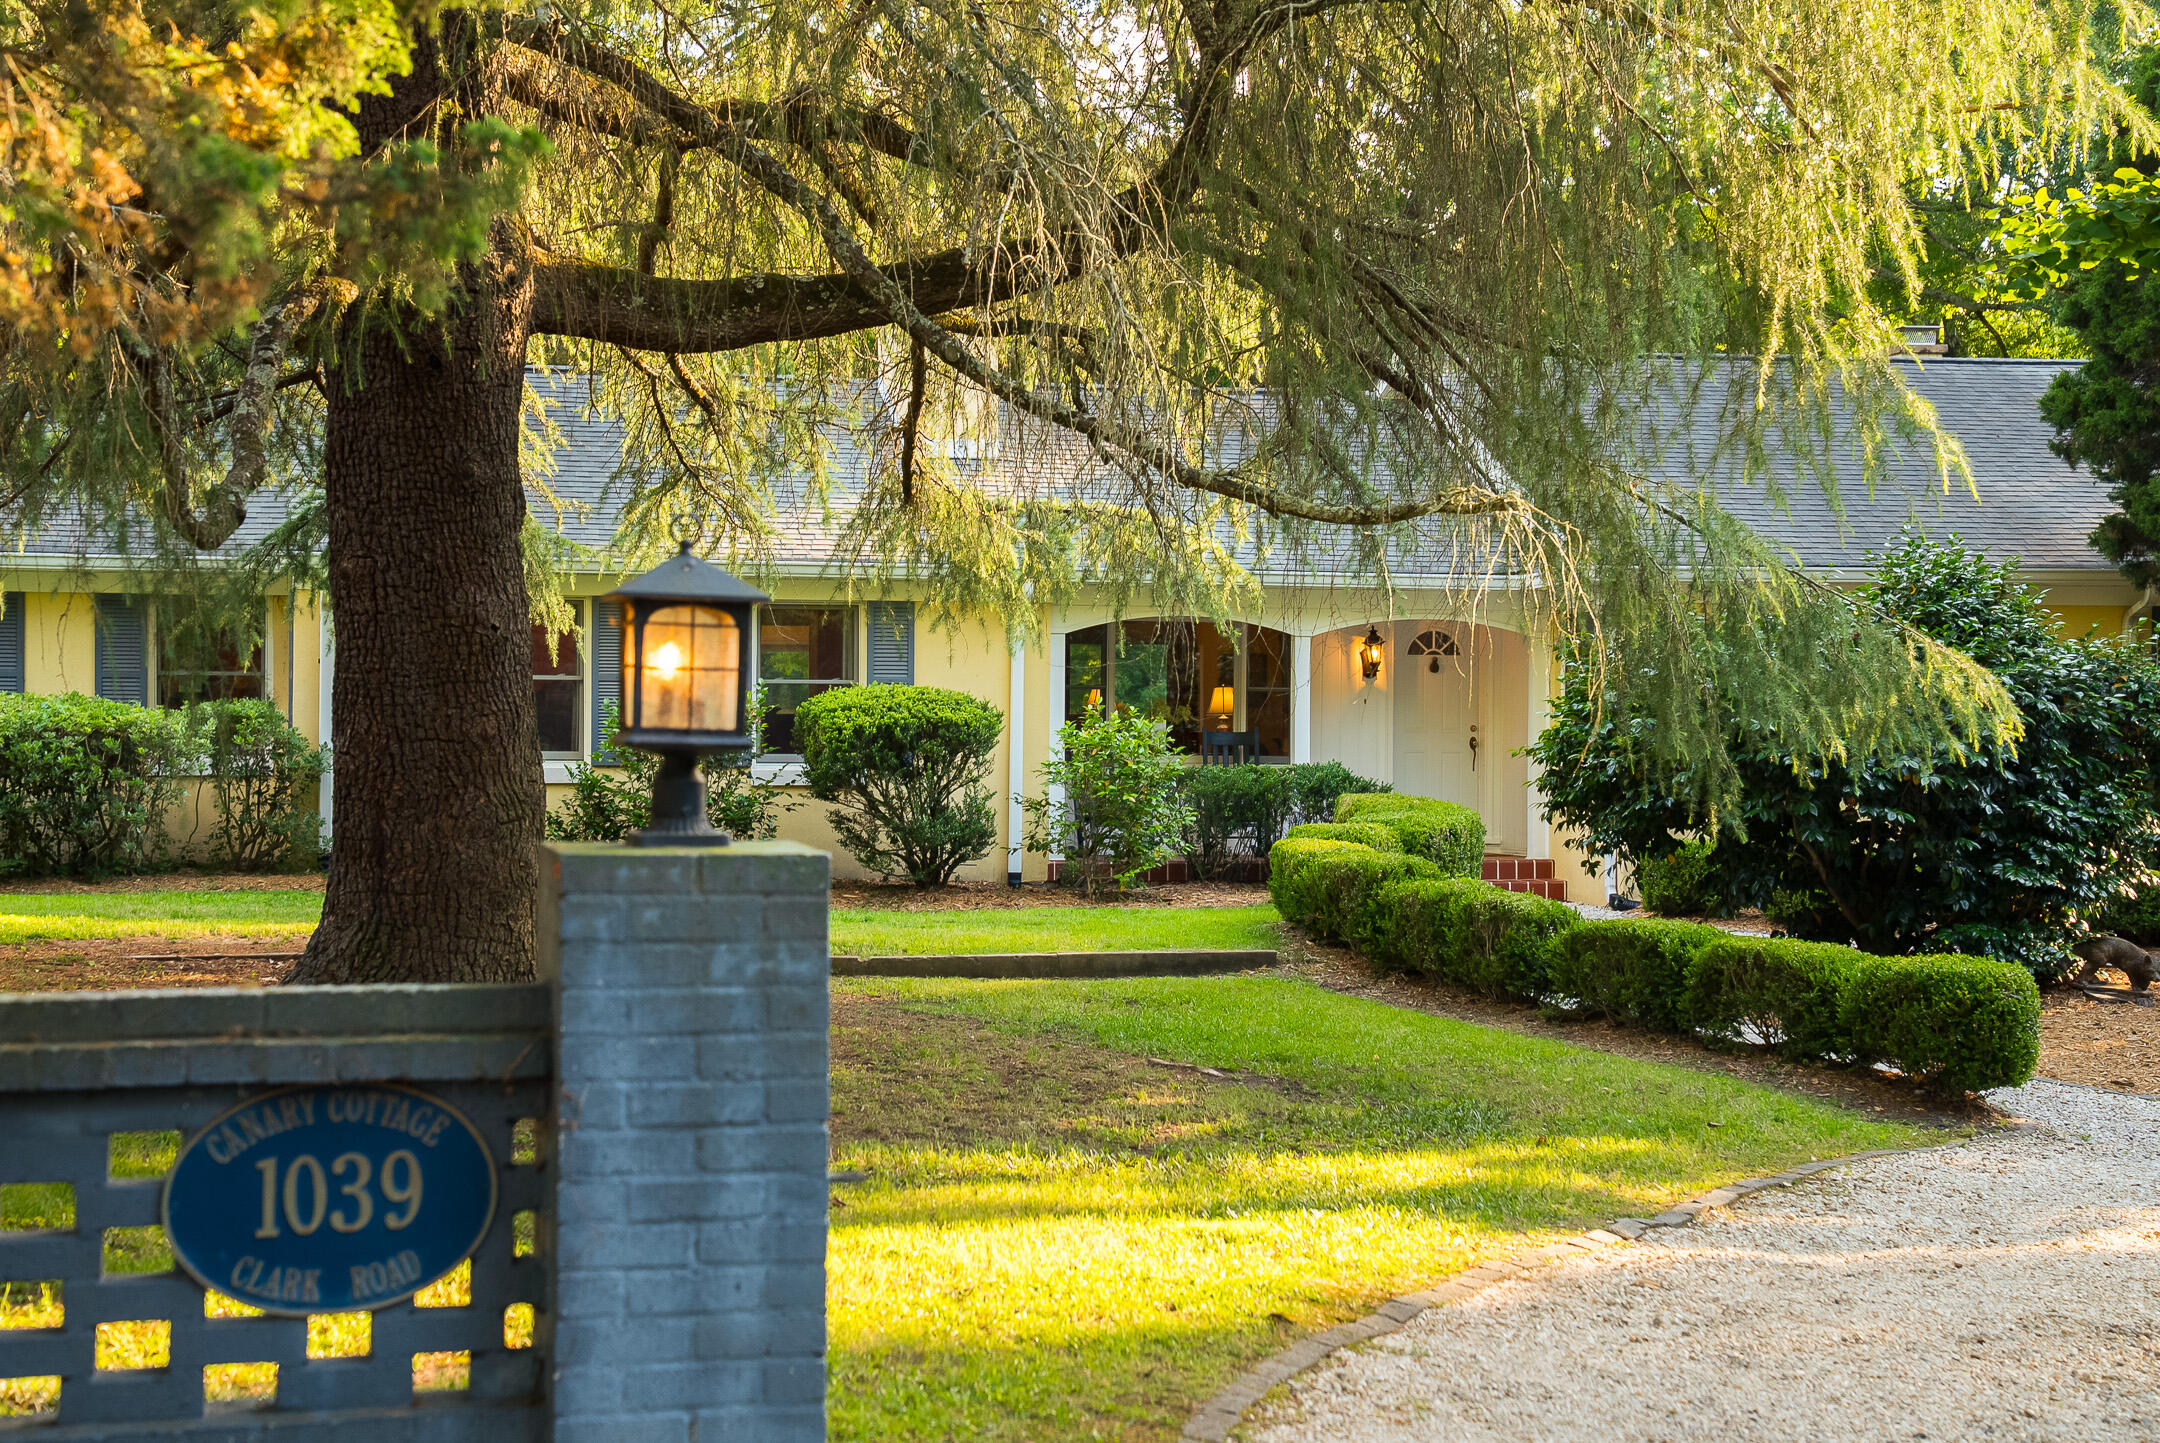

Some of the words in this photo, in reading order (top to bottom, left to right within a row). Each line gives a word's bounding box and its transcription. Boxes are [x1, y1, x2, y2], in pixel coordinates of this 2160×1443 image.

[205, 1094, 315, 1165] CANARY
[327, 1092, 450, 1148] COTTAGE
[255, 1149, 424, 1239] 1039
[230, 1256, 321, 1303] CLARK
[350, 1250, 422, 1299] ROAD
